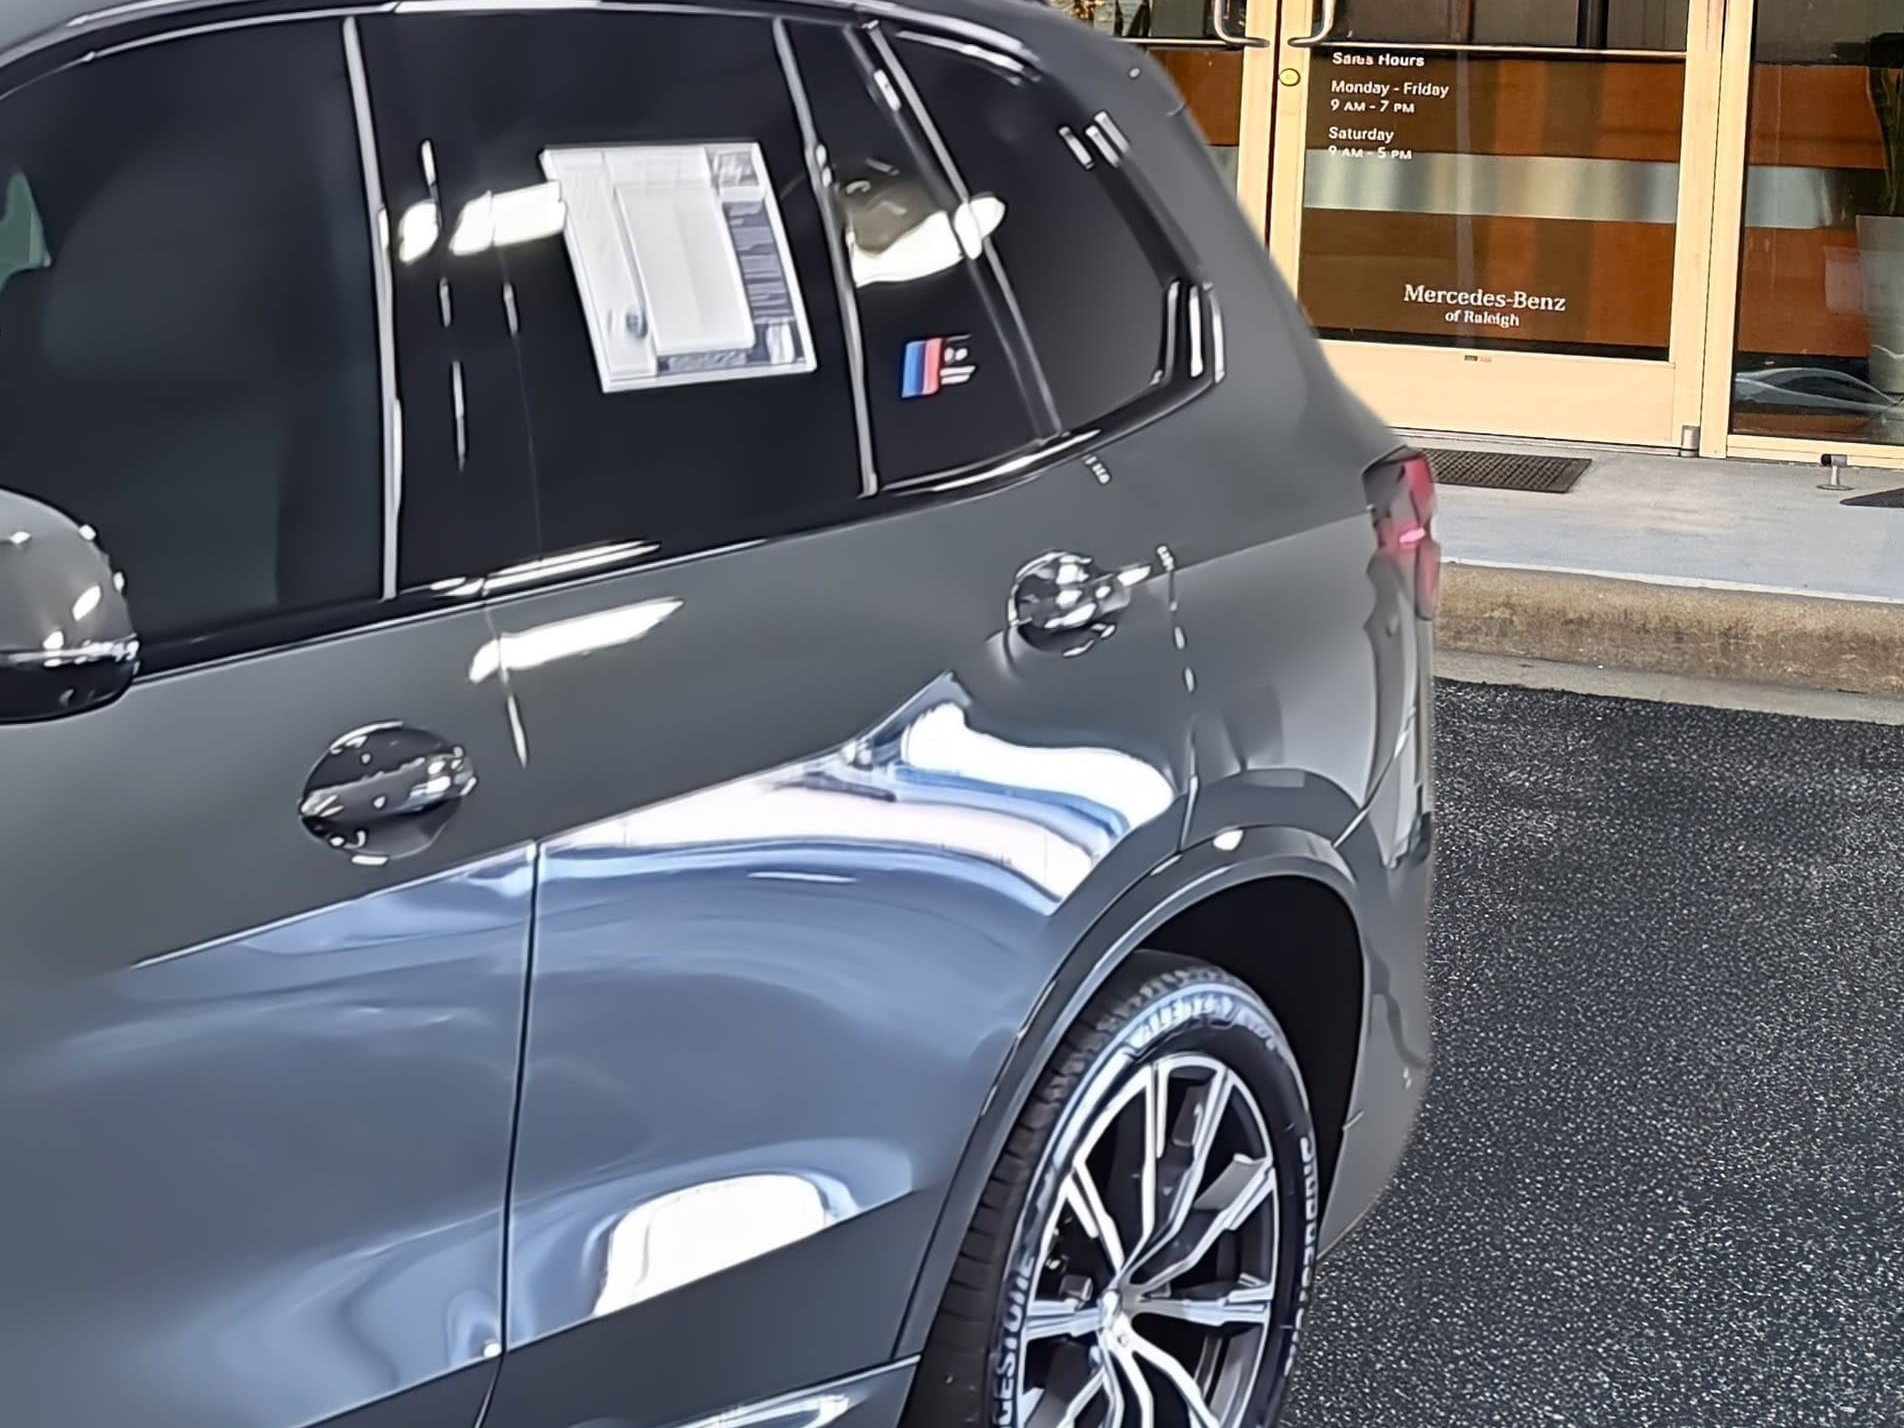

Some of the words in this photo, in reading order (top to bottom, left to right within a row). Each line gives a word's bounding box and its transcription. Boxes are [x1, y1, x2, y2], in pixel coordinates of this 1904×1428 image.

[1378, 53, 1425, 66] Hours
[1331, 80, 1390, 97] Monday
[1403, 82, 1449, 99] Friday
[1330, 99, 1340, 111] 9
[1343, 102, 1366, 111] AM
[1380, 100, 1389, 112] 7
[1393, 103, 1415, 113] PM
[1328, 126, 1394, 144] Saturday
[1377, 146, 1387, 159] 5
[1391, 150, 1412, 160] PM
[1403, 284, 1566, 312] Mercedes-Benz
[1445, 309, 1463, 322] of
